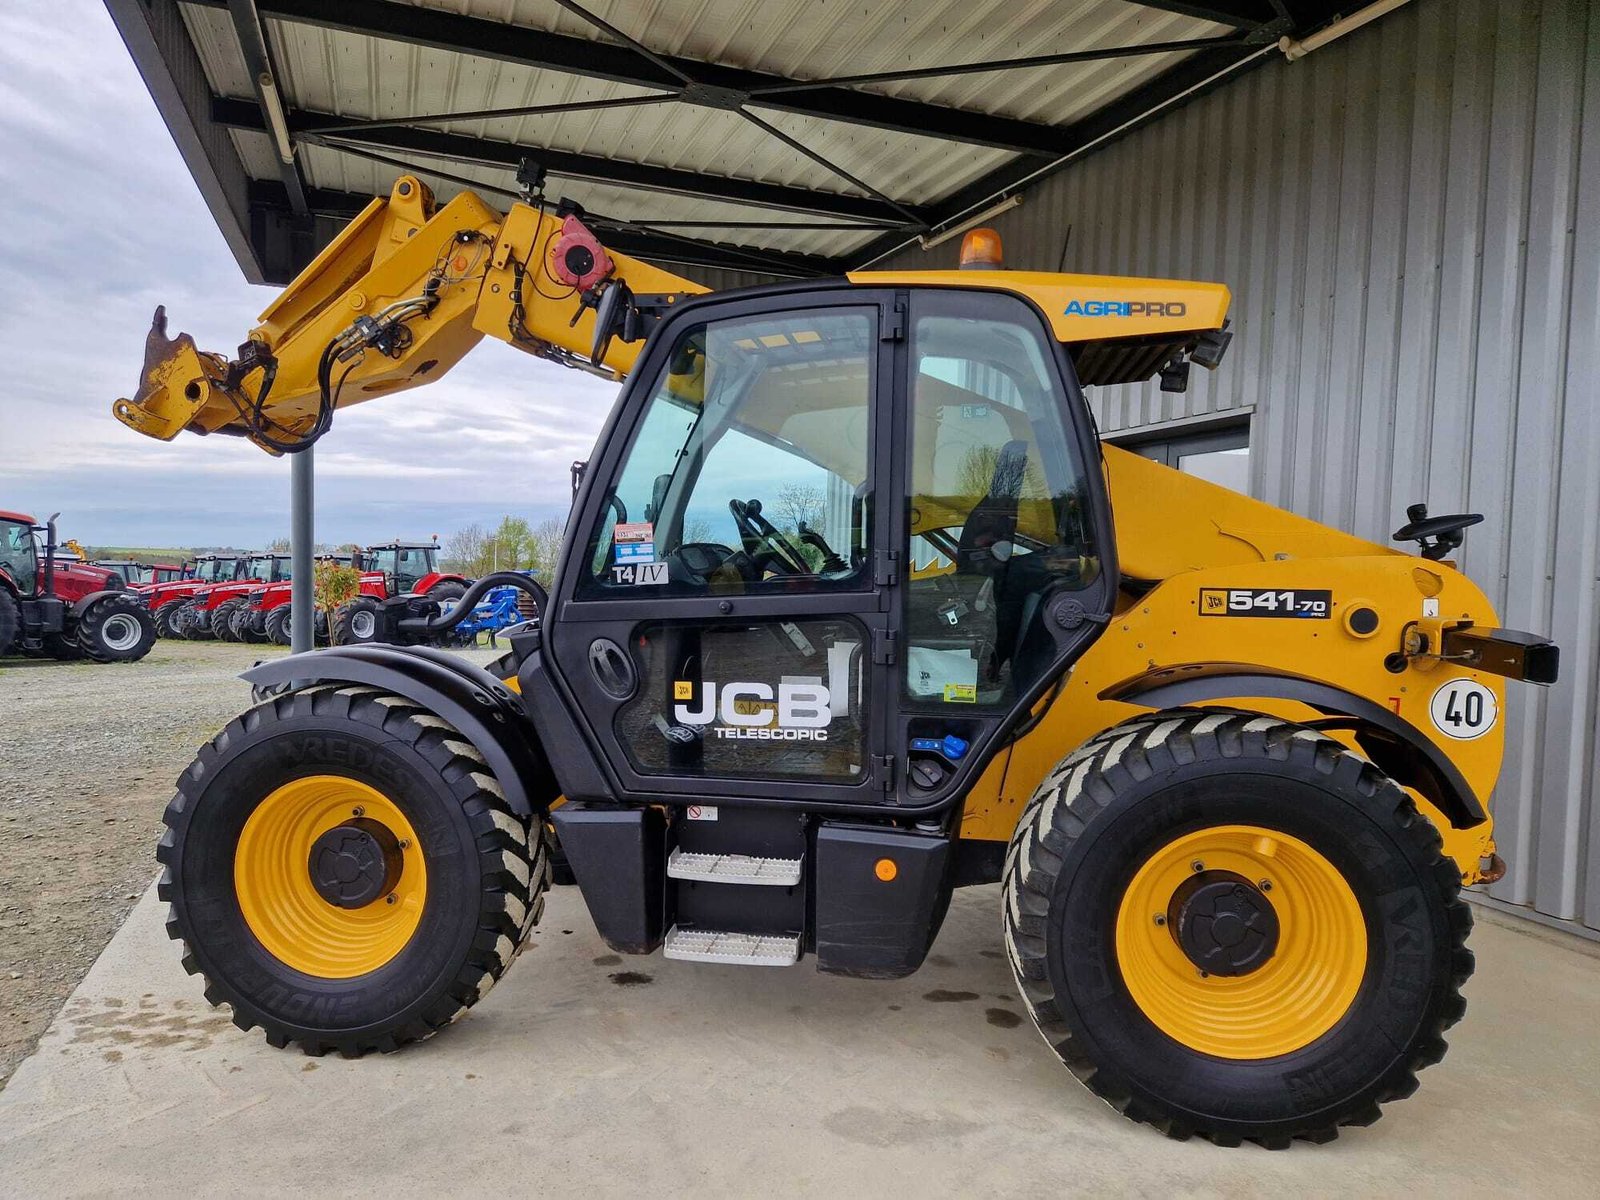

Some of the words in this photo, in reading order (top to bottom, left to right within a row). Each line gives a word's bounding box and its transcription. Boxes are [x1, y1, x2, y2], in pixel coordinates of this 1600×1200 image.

[1063, 300, 1186, 317] AGRIPRO
[612, 566, 635, 583] T4
[640, 565, 665, 582] IV
[1205, 595, 1223, 609] JCB
[674, 682, 831, 728] JCB
[1444, 690, 1484, 729] 40
[714, 727, 828, 741] TELESCOPIC
